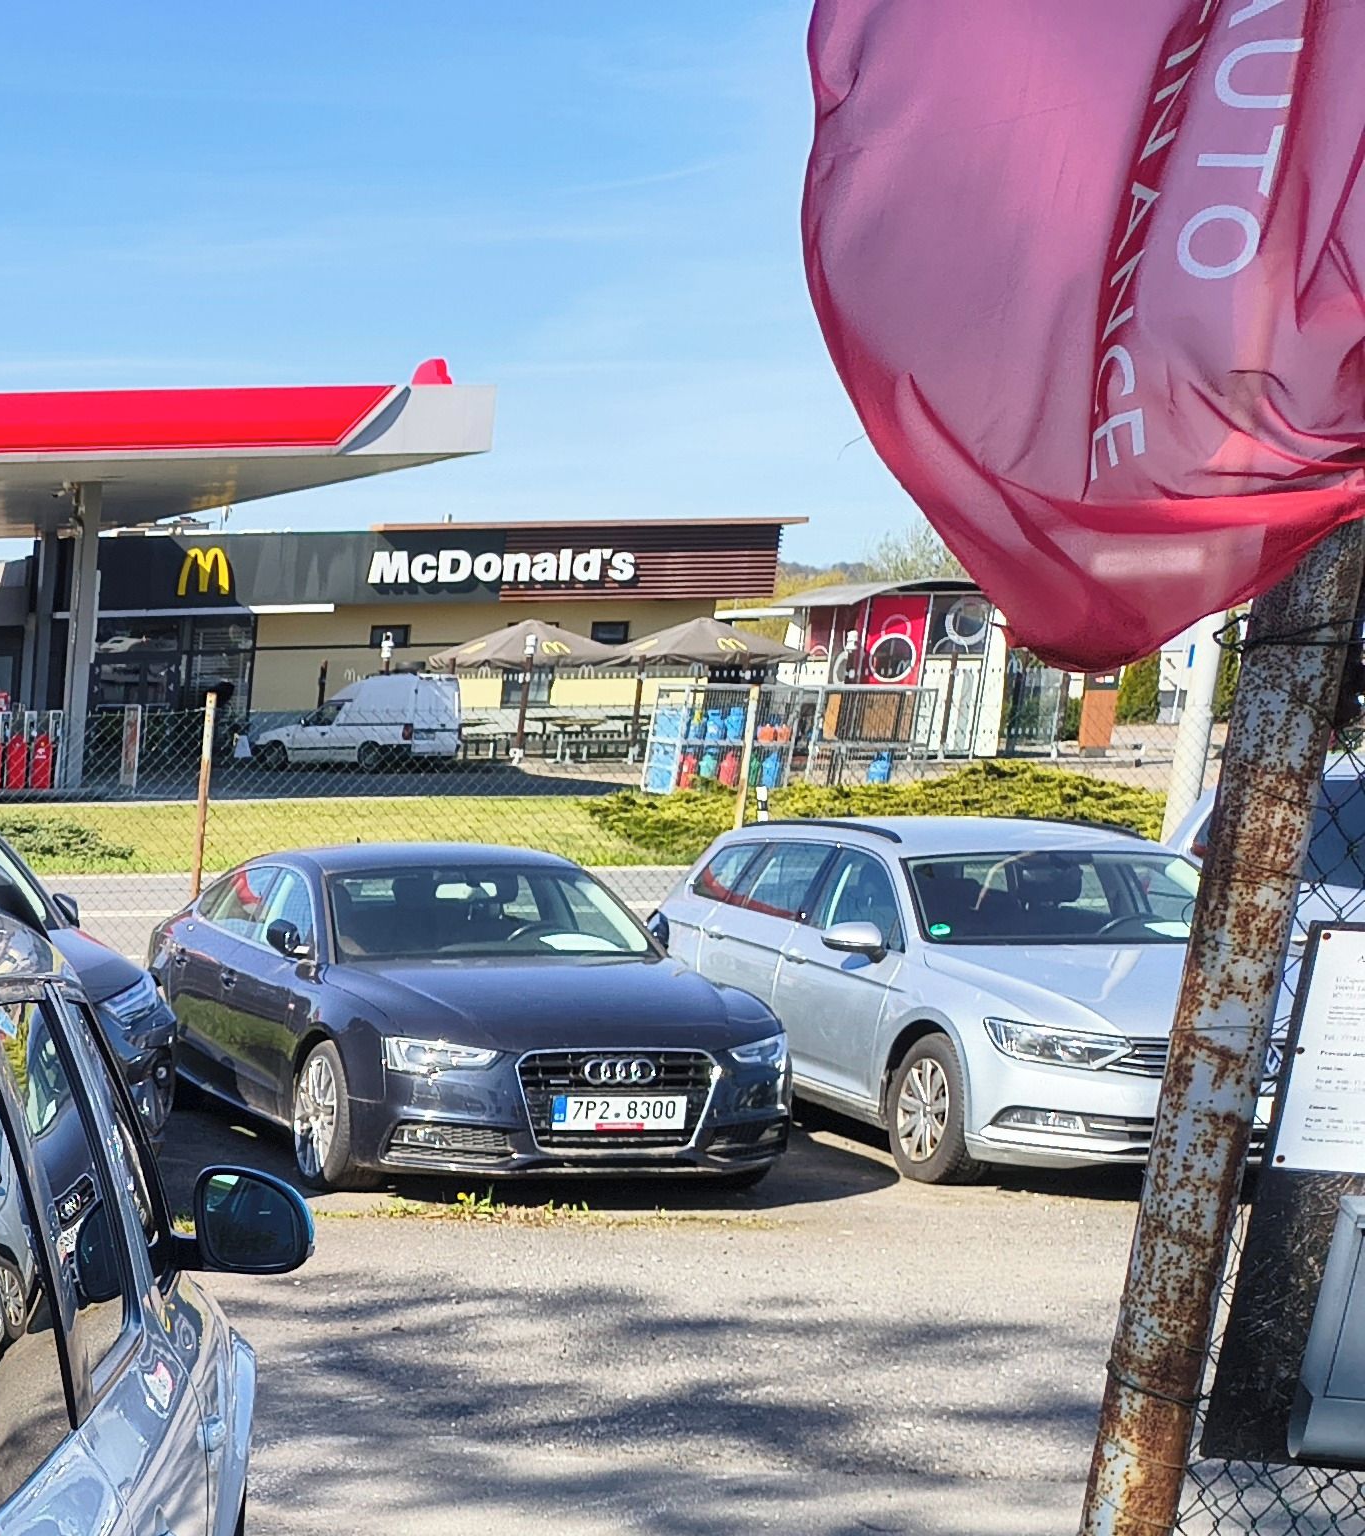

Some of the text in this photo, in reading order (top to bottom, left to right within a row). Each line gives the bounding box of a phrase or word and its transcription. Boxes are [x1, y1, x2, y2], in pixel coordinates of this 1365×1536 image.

[368, 548, 635, 585] McDonald's
[573, 1100, 610, 1120] 7P2
[626, 1100, 676, 1120] 8300
